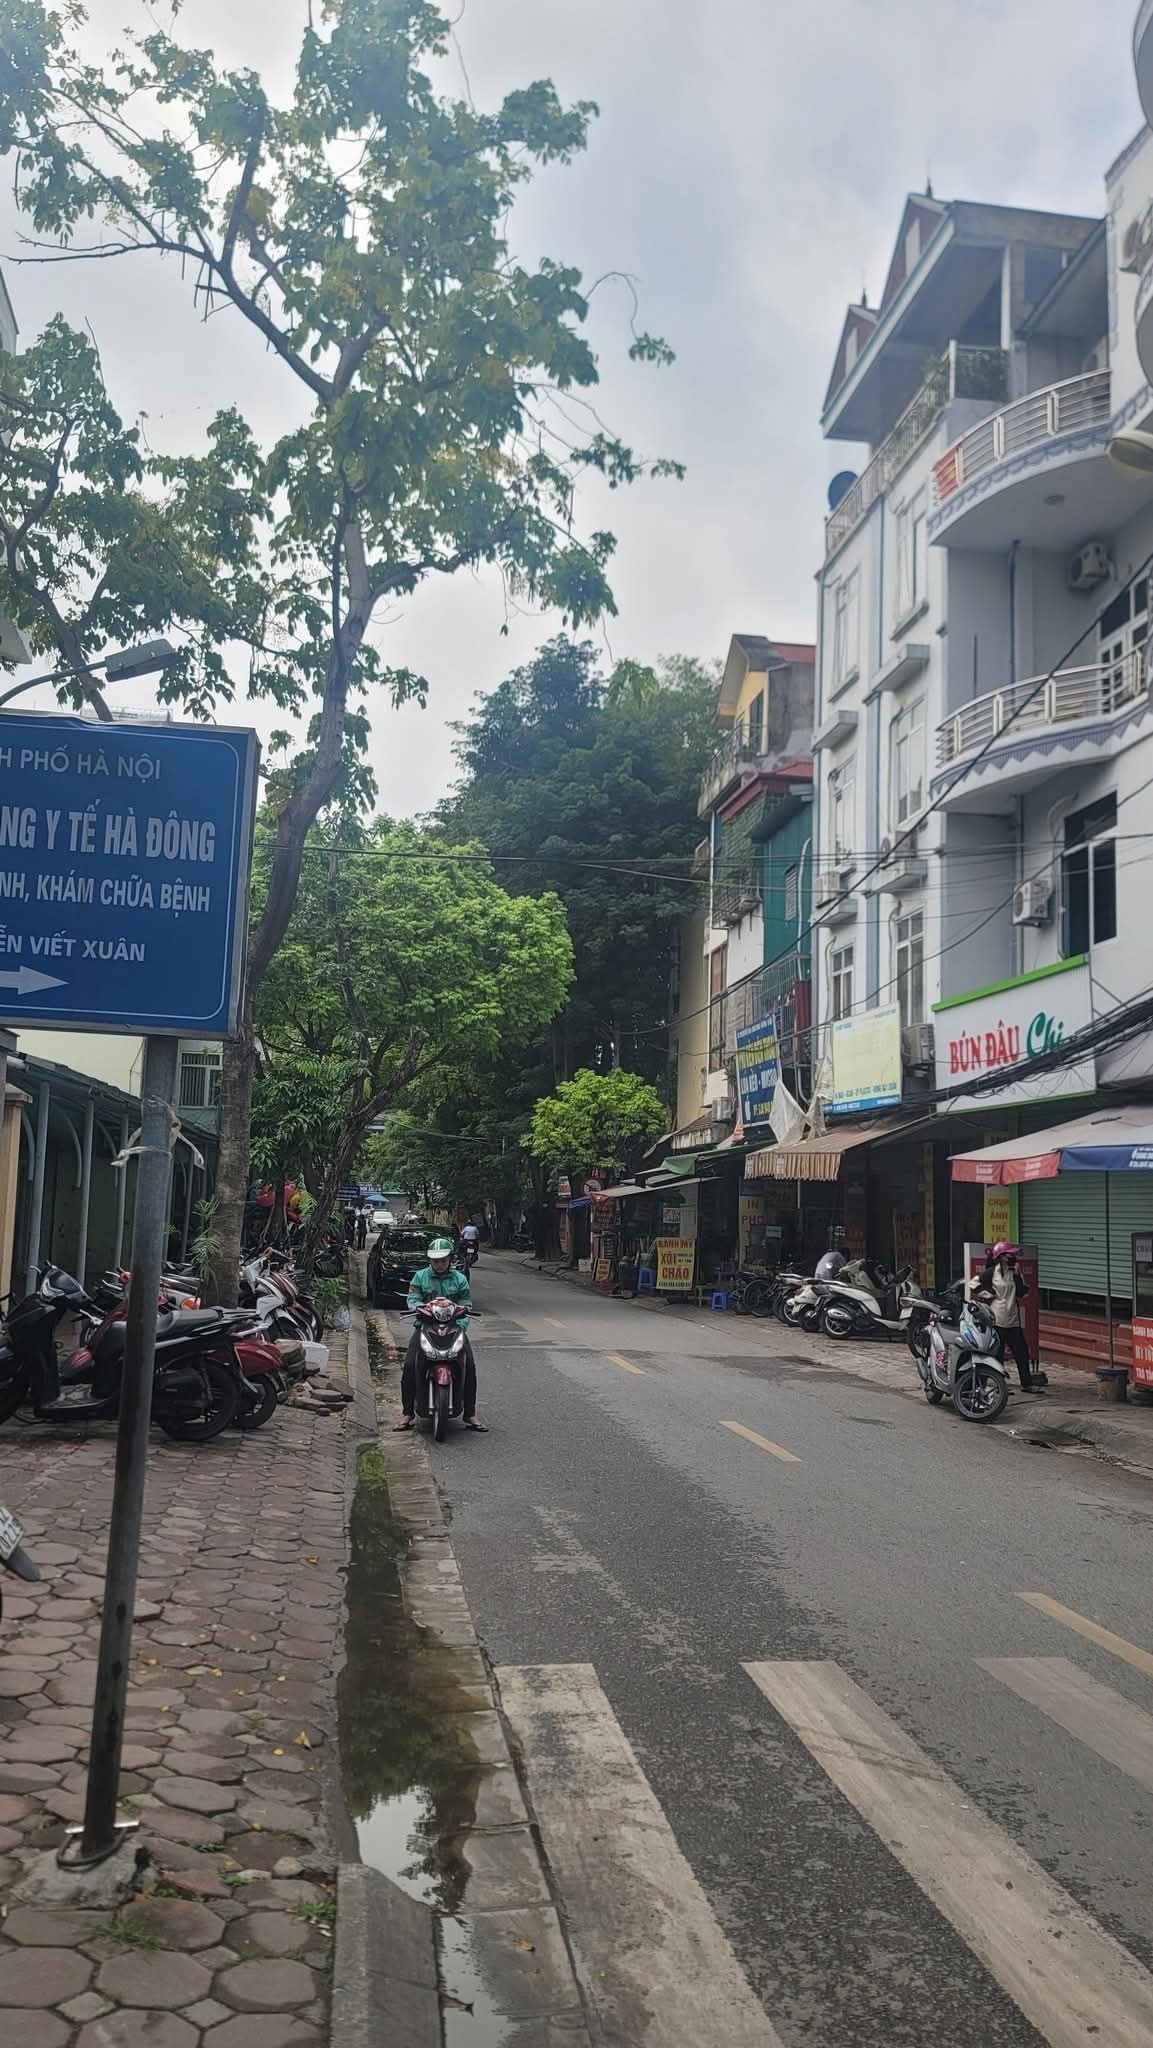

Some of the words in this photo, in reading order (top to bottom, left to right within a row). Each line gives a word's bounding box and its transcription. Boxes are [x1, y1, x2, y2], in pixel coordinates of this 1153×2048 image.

[21, 744, 69, 772] PHỐ
[77, 748, 110, 776] HÀ
[118, 753, 160, 783] NỘI
[0, 806, 36, 848] NG
[46, 810, 61, 849] Y
[69, 799, 100, 852] TẾ
[104, 807, 138, 856] HÀ
[146, 810, 215, 862] ĐÔNG
[37, 869, 95, 903] KHÁM
[100, 874, 154, 908] CHỮA
[160, 878, 210, 918] BỆNH
[30, 930, 77, 956] VIẾT
[81, 937, 146, 961] XUÂN
[949, 1029, 981, 1073] BÚN
